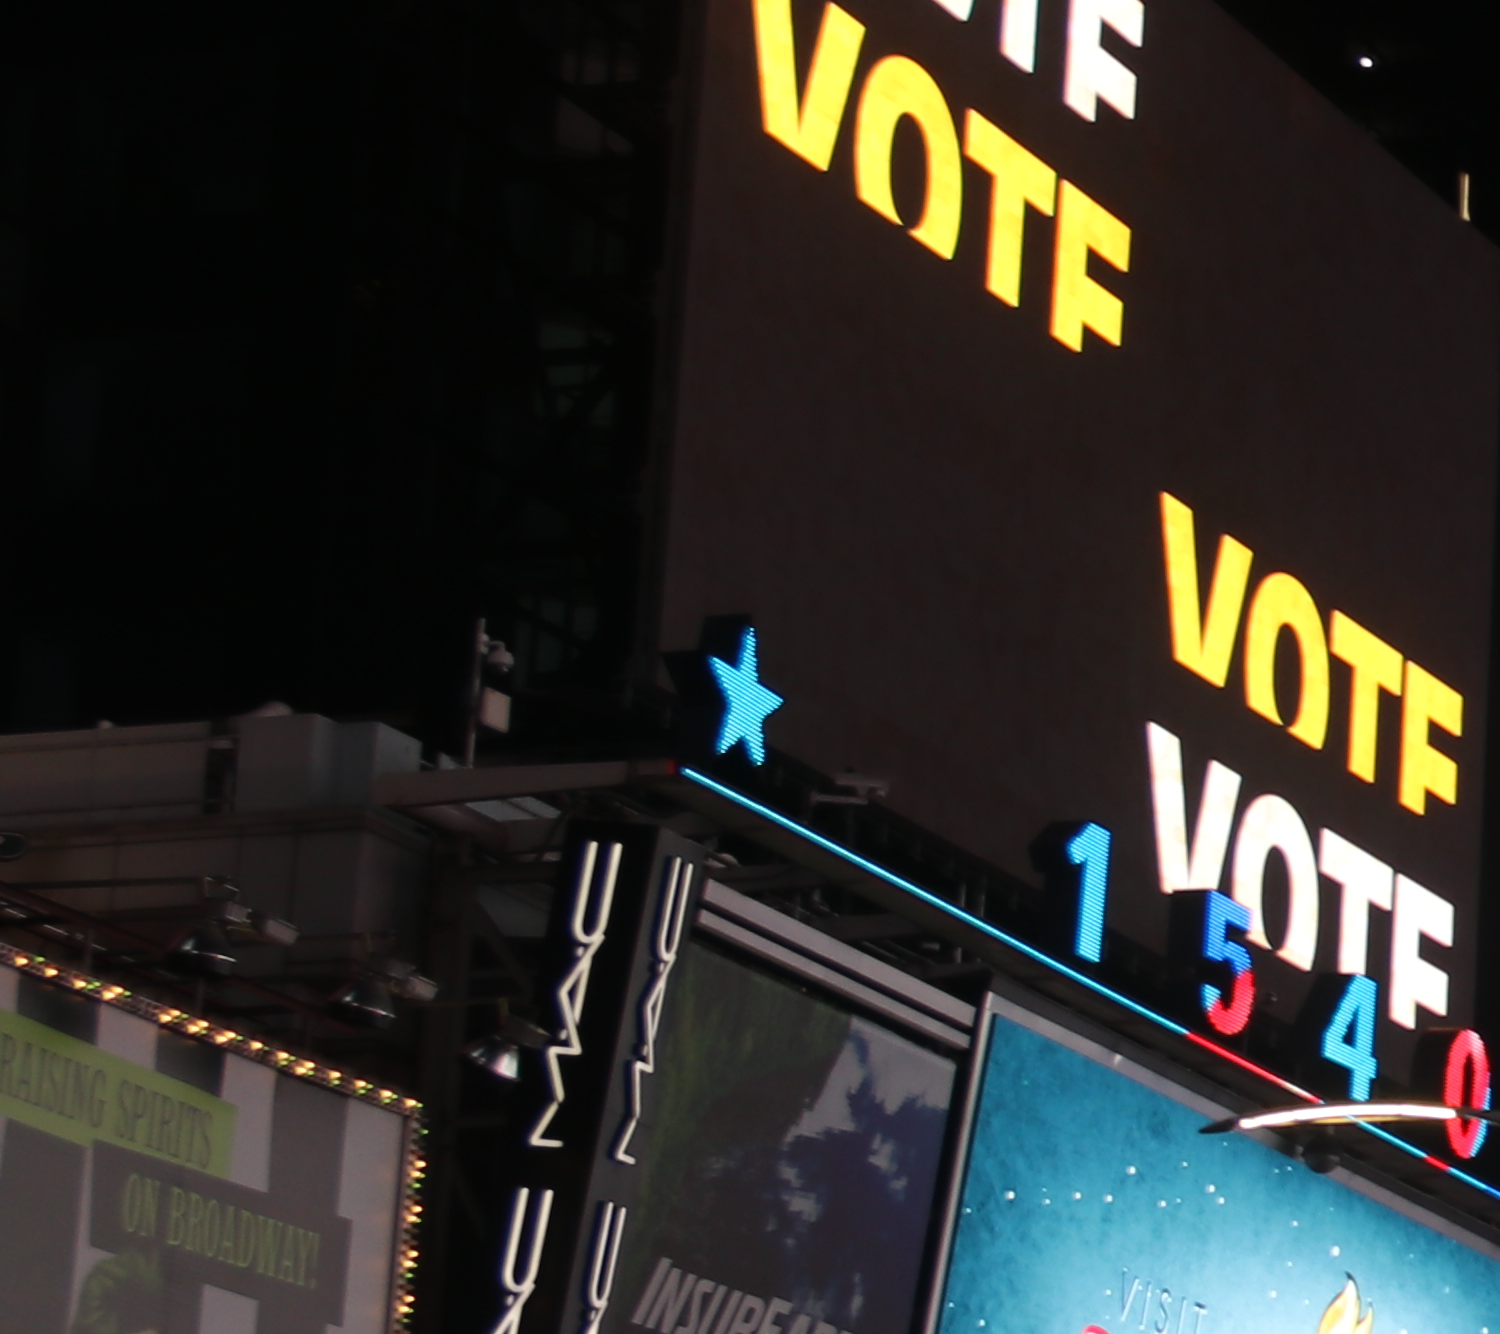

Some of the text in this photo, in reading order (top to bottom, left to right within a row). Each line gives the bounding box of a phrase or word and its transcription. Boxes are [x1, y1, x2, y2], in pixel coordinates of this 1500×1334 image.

[1066, 821, 1491, 1159] 1540
[114, 1079, 213, 1169] SPIRITS
[122, 1172, 321, 1291] ON BROADWAY!
